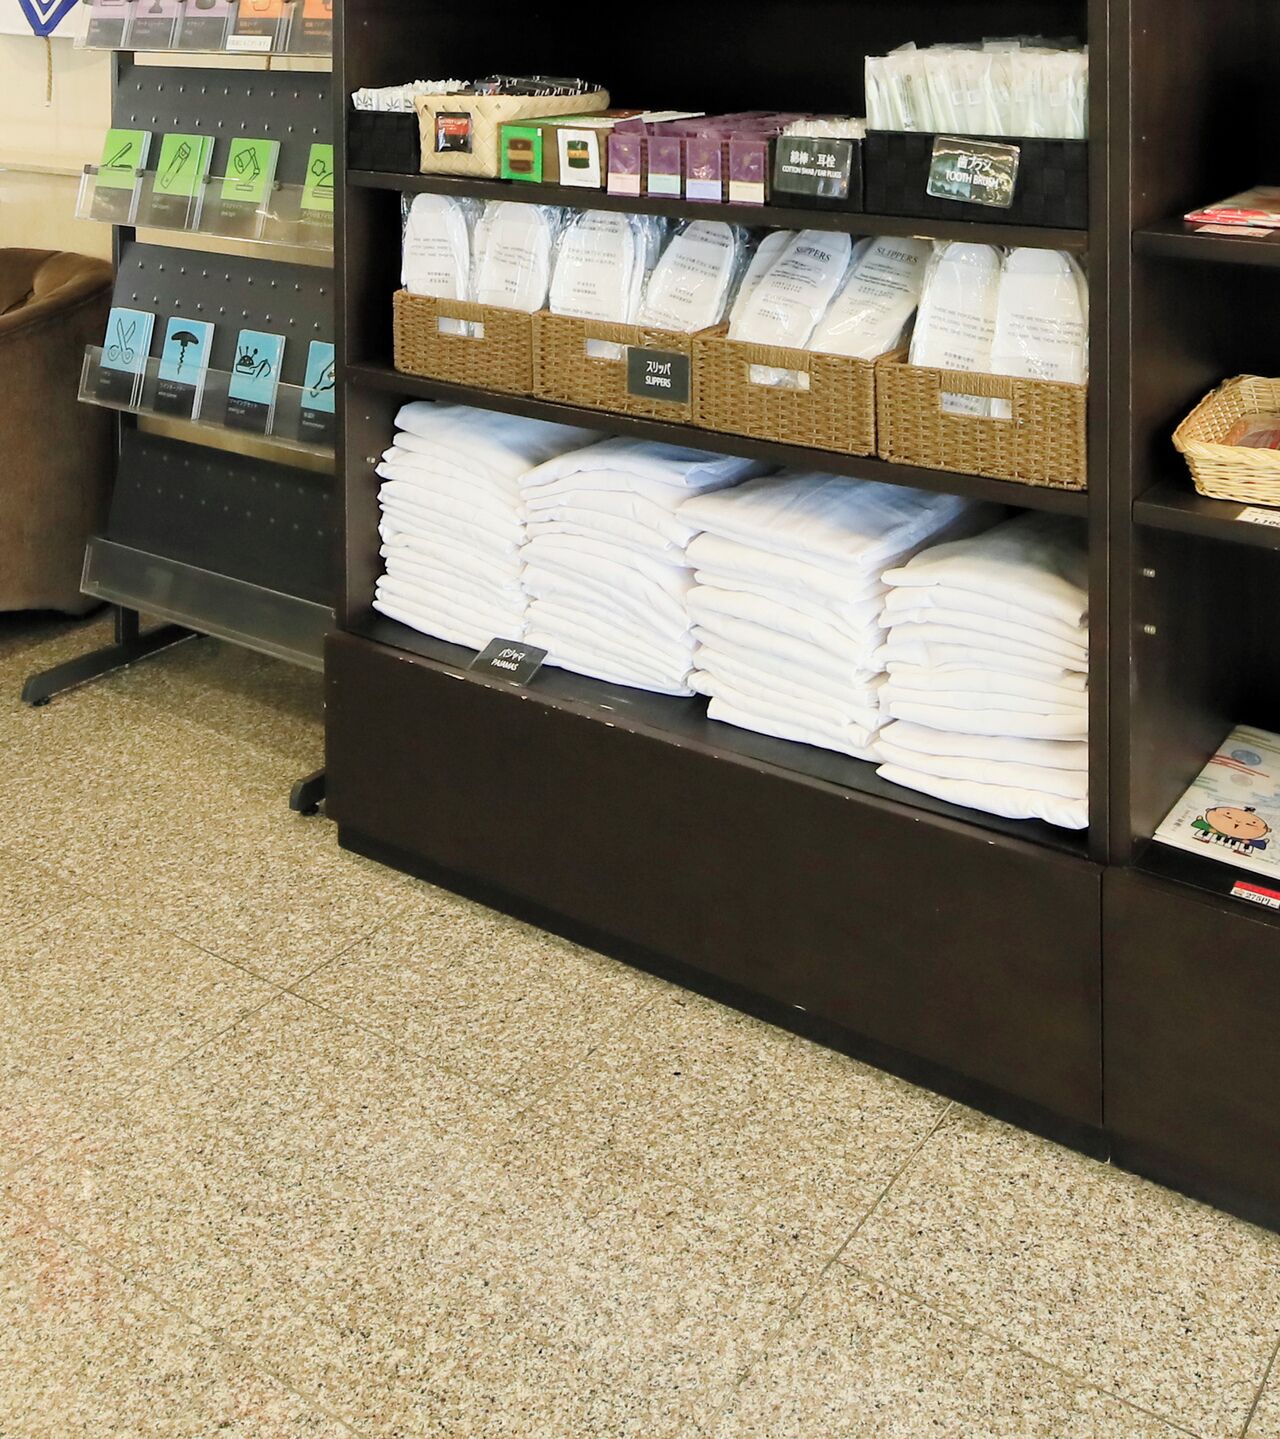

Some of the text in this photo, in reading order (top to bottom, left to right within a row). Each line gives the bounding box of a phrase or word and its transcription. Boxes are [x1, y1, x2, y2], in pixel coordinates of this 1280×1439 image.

[945, 169, 1001, 189] TOOTH BRUSH
[876, 247, 918, 263] SLIPPERS
[646, 361, 670, 375] スリッパ
[645, 375, 671, 388] SLIPPERS
[490, 658, 520, 672] PAJAMAS
